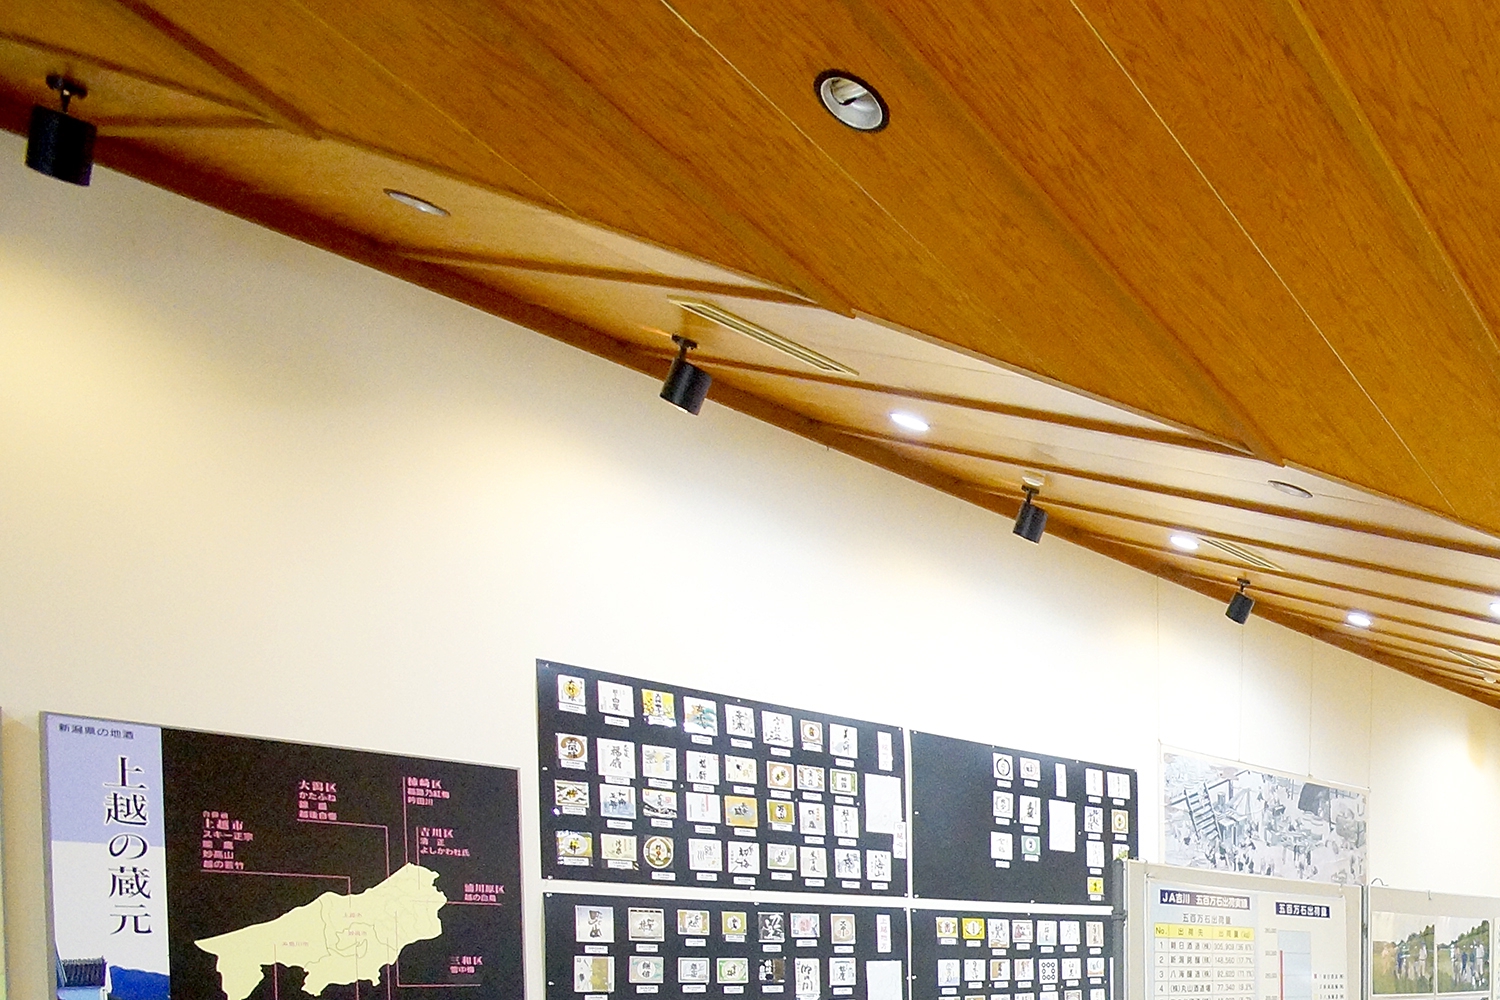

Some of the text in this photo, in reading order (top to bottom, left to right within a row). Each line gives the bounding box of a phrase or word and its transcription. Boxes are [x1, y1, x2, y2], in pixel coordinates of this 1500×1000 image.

[58, 723, 135, 740] 新潟県の地酒
[204, 818, 243, 831] 上越市
[420, 827, 454, 838] 吉川区
[104, 756, 153, 936] 上越の蔵元
[420, 847, 471, 857] よしかわ杜氏
[1162, 892, 1191, 905] JA吉川
[1183, 913, 1231, 925] 五百万石出荷量
[1155, 927, 1167, 935] No.
[449, 956, 483, 965] 三和区
